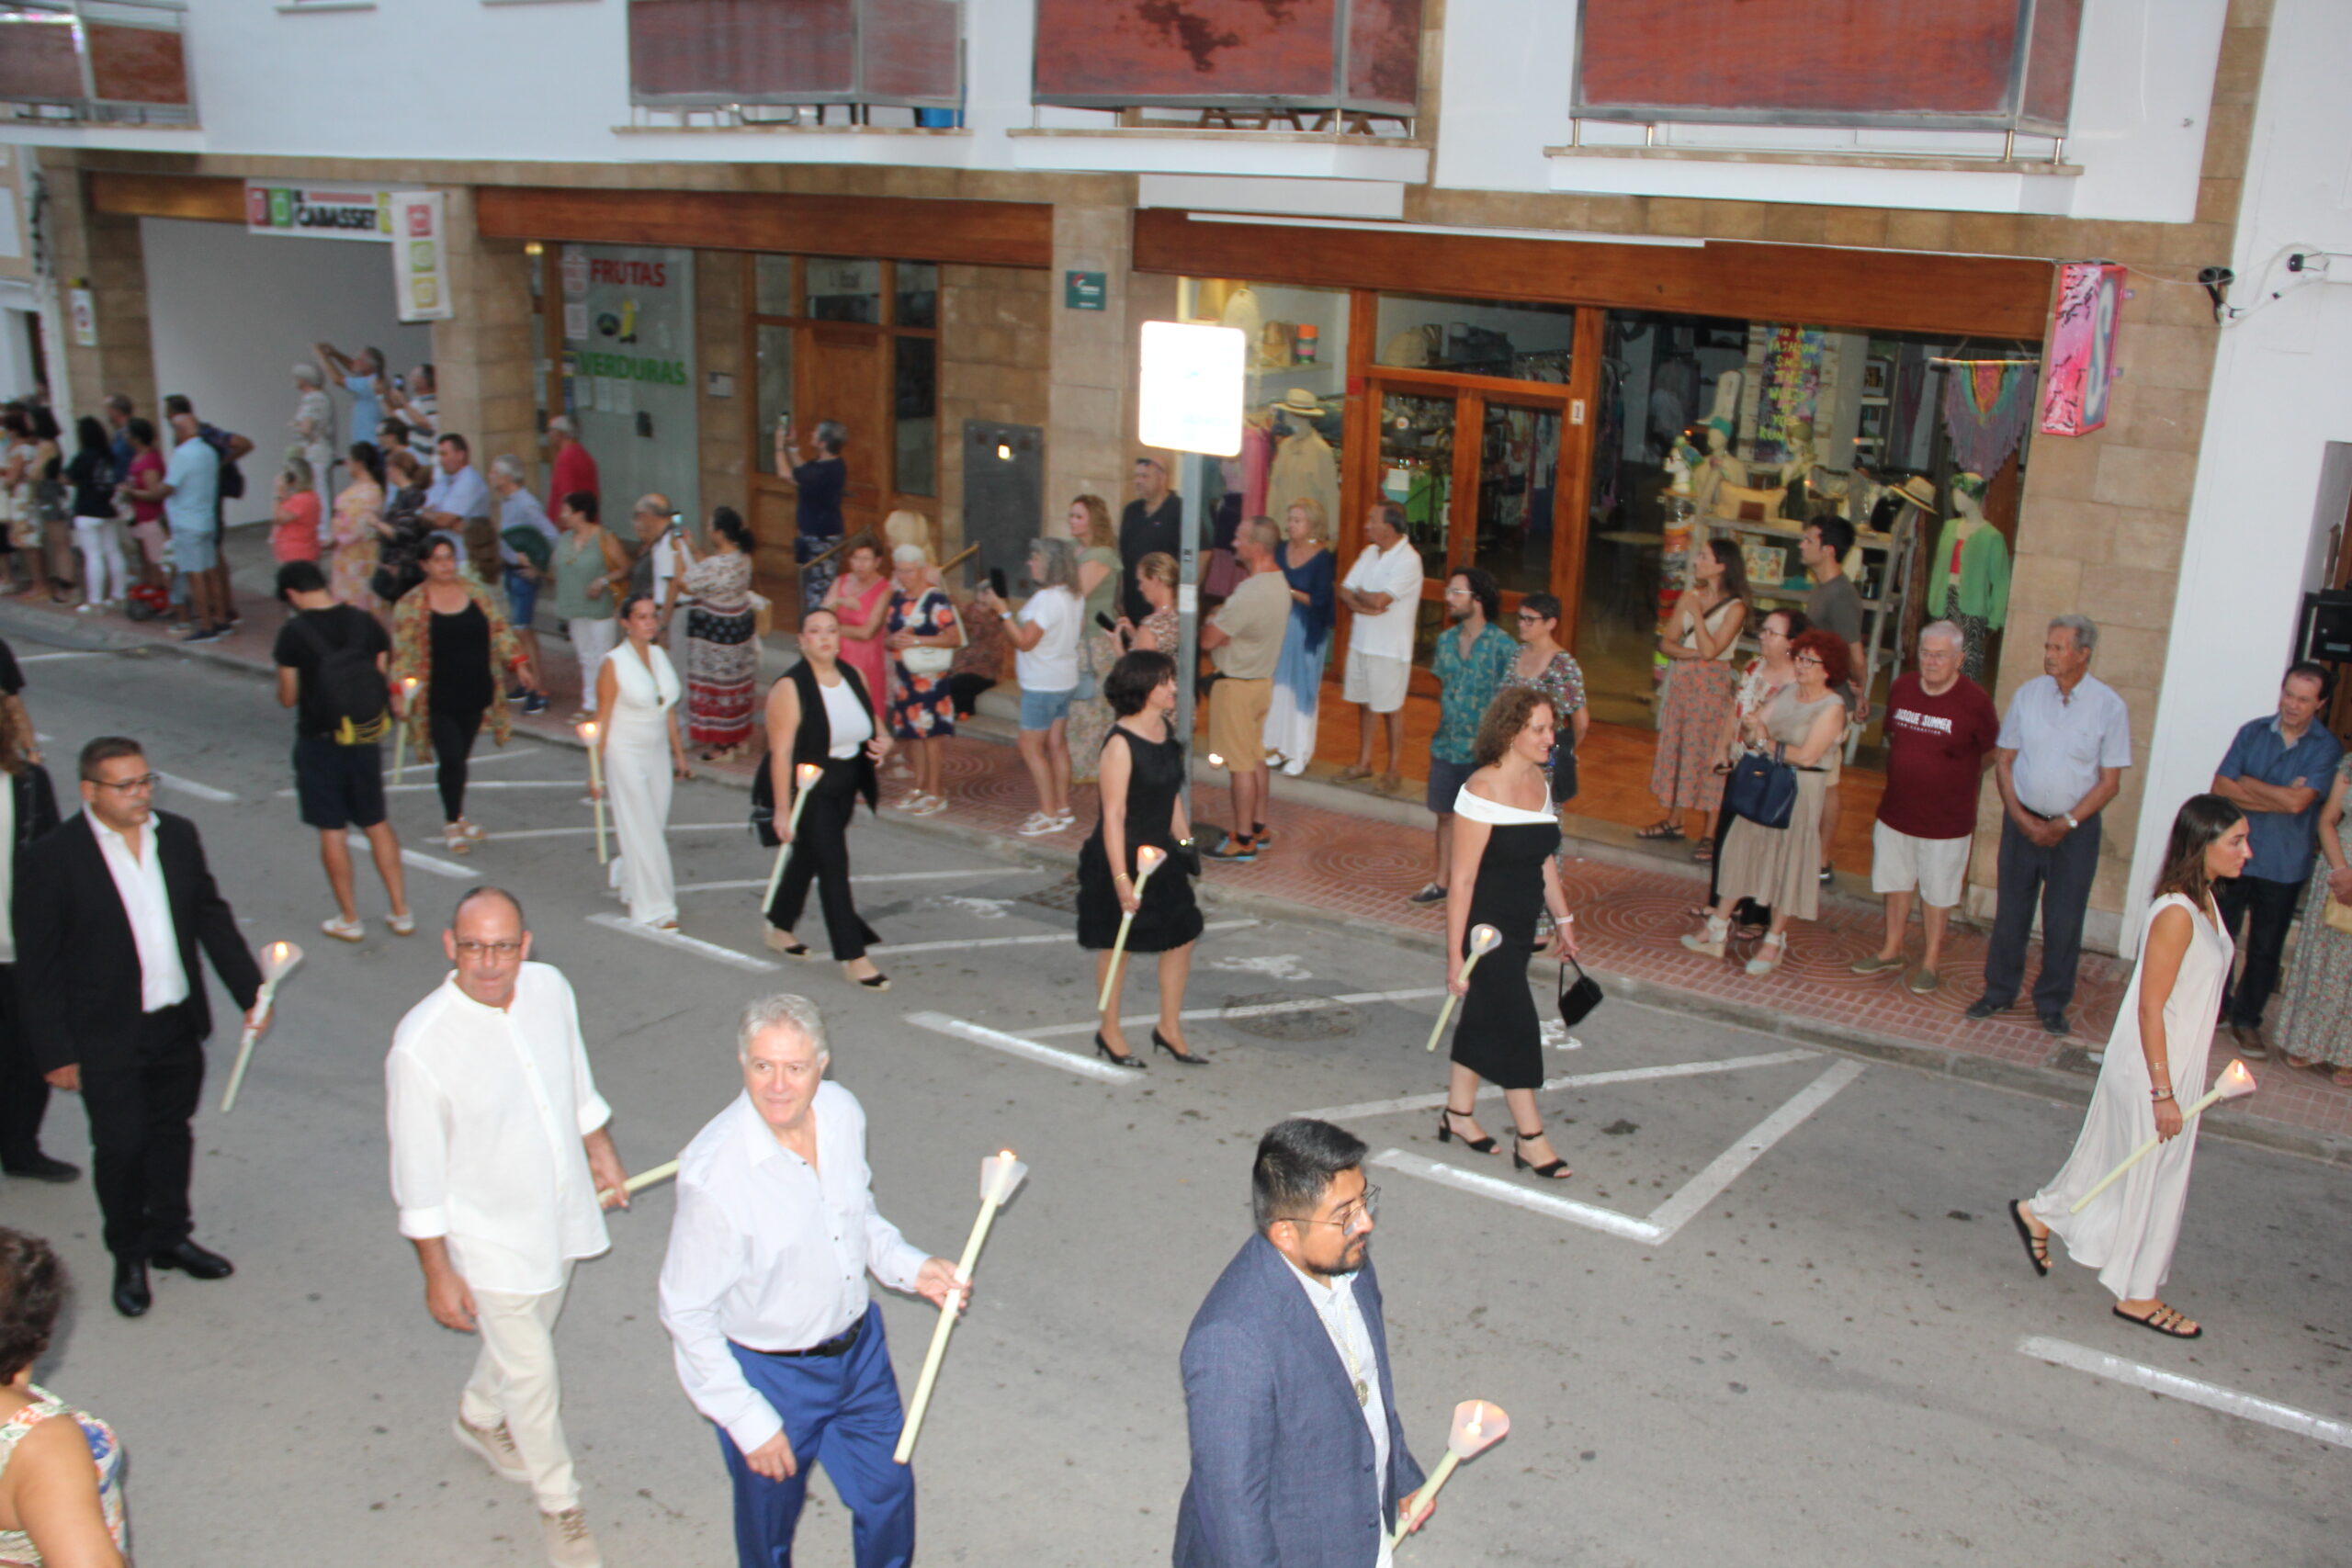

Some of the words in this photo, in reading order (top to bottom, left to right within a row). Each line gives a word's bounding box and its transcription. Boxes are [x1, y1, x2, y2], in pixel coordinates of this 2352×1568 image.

[591, 258, 666, 288] FRUTAS
[578, 350, 687, 385] VERDURAS
[1923, 715, 1951, 734] SUMMER
